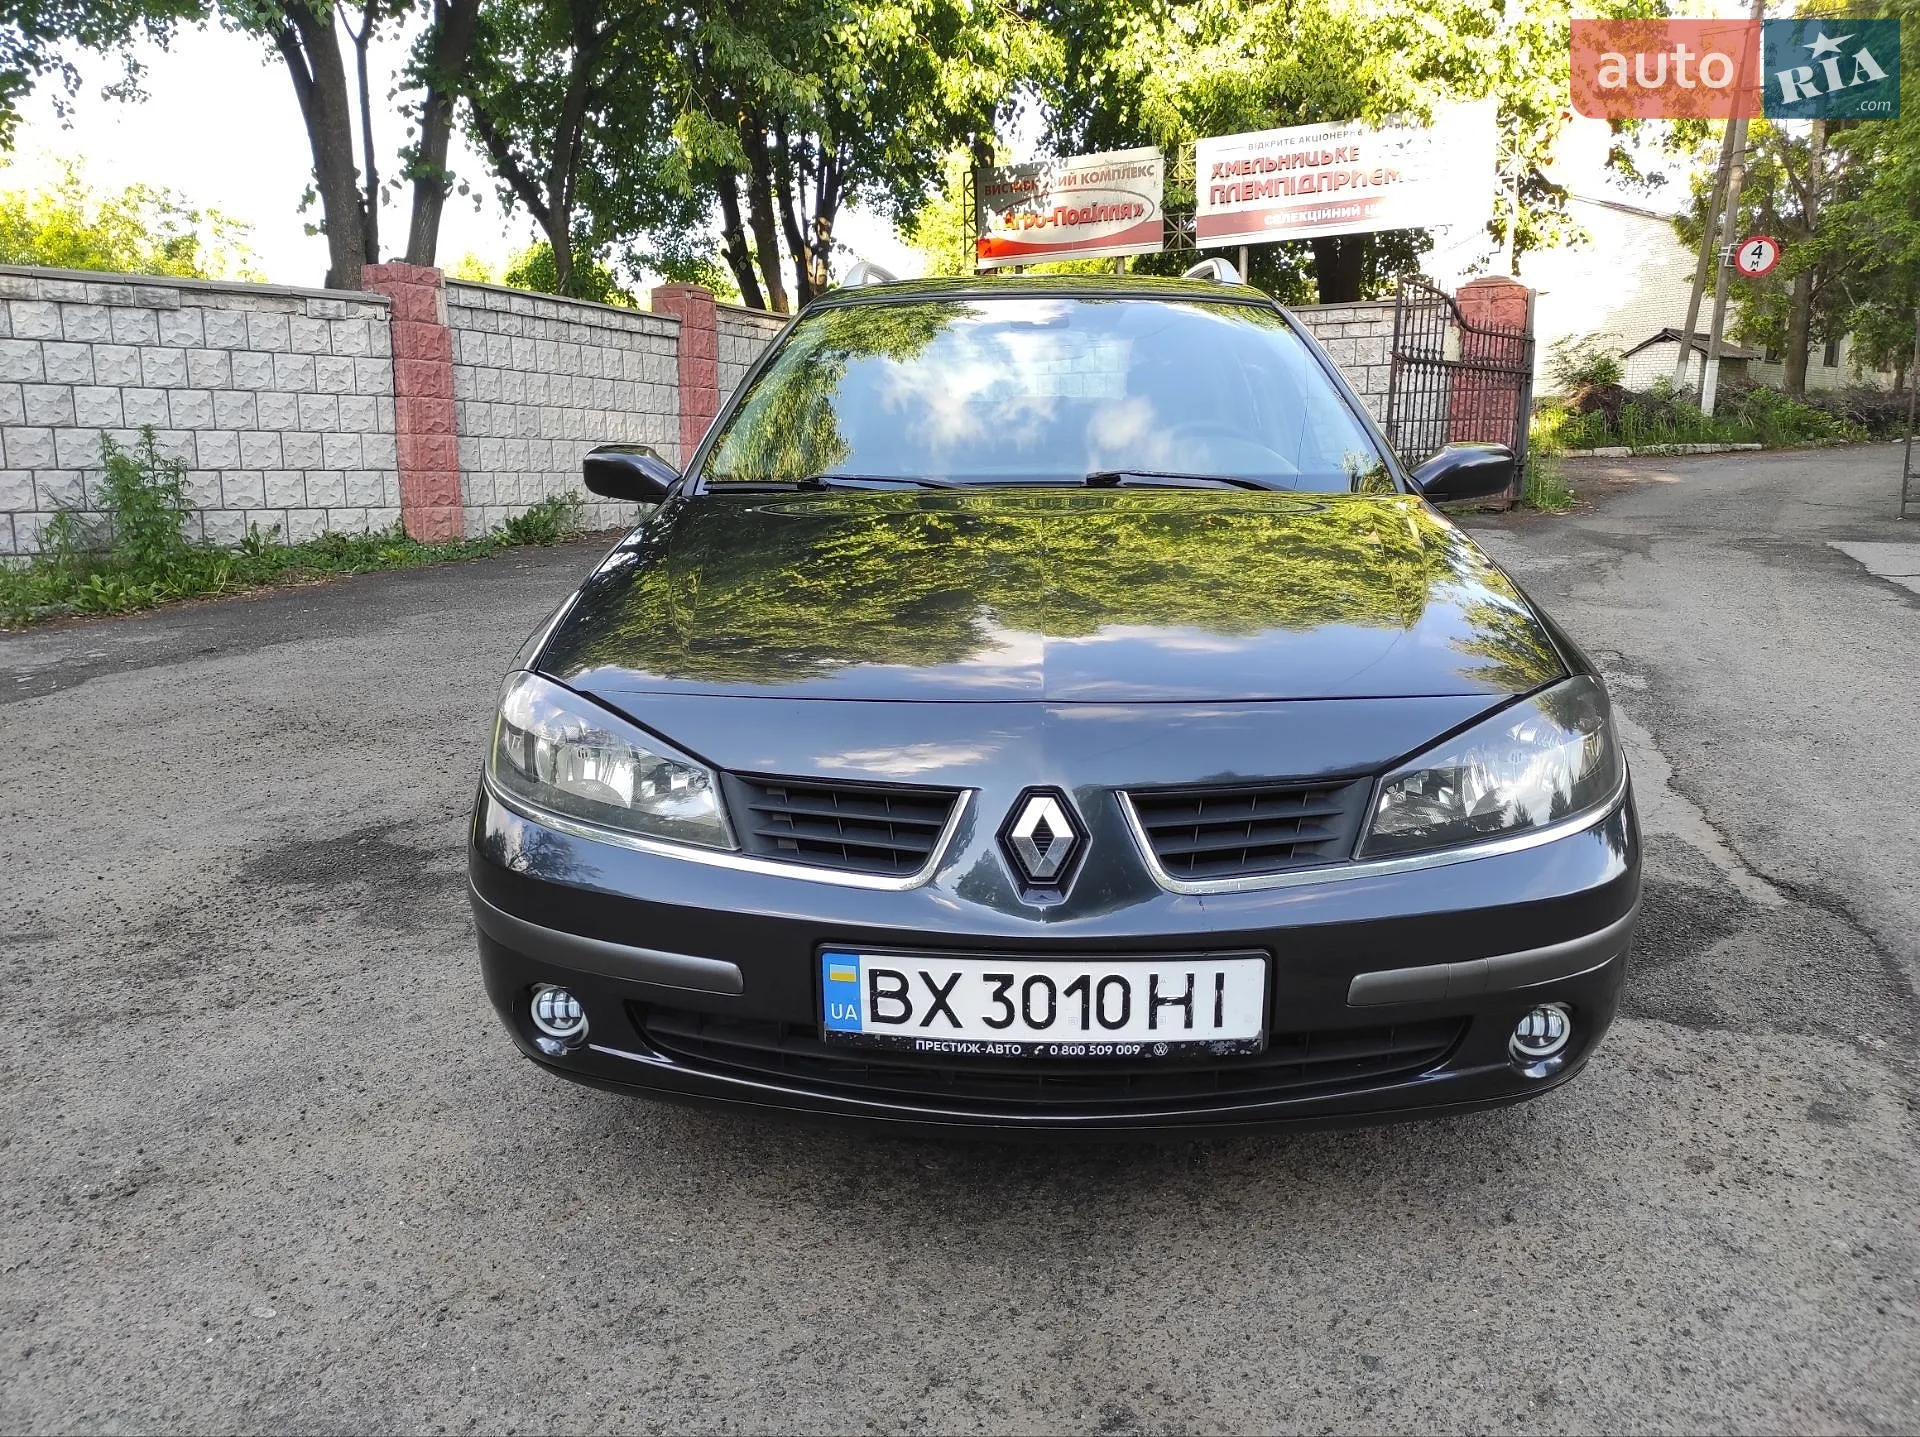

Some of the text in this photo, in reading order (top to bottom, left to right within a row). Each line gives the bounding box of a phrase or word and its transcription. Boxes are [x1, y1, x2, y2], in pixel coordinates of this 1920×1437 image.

[1211, 146, 1360, 180] ХМЕЛЬНИЦЬКЕ
[984, 164, 1156, 196] ВИСТАВКИЙ КОМПЛЕКС
[993, 201, 1144, 230] Агро-Поділля»
[1751, 244, 1763, 259] 4
[830, 1003, 858, 1022] UA
[868, 968, 963, 1029] BX
[981, 972, 1131, 1031] 3010
[915, 1039, 1140, 1056] ПРЕСТИЖ-АВТО 0 800 509 009
